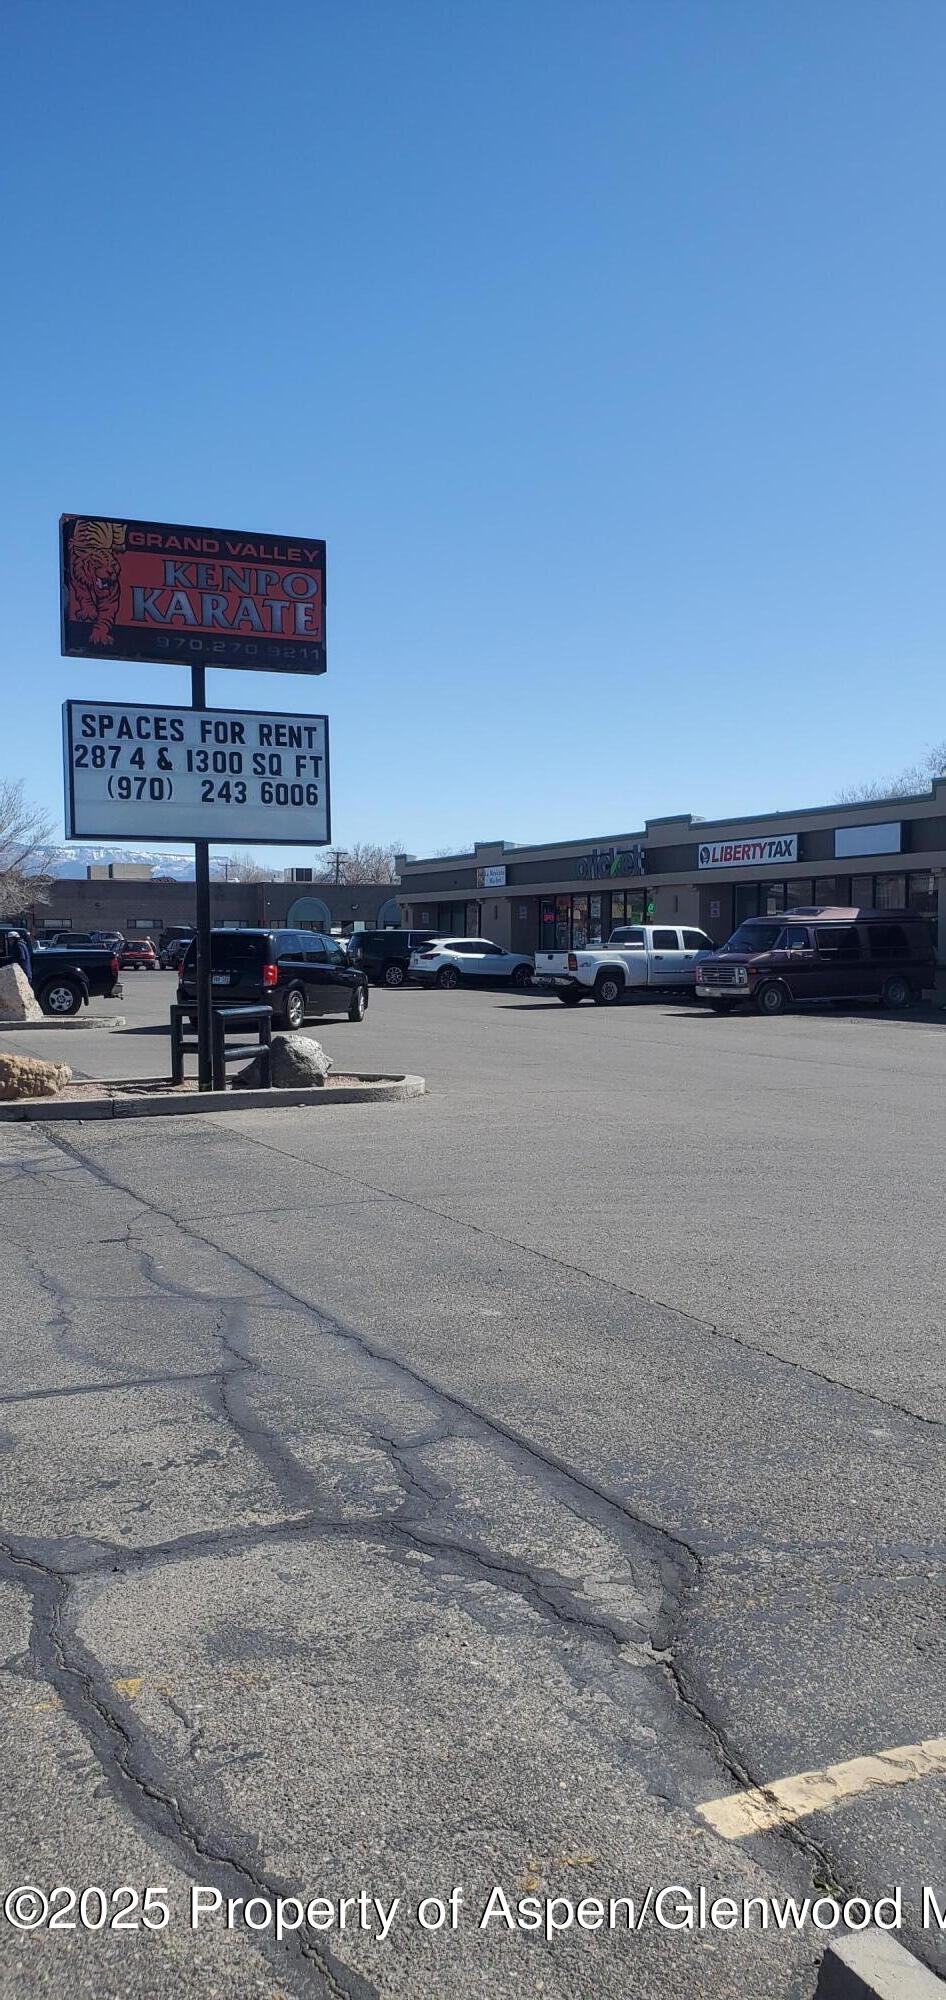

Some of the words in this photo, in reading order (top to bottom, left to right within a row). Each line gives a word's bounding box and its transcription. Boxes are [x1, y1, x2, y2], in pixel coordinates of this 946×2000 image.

[128, 531, 220, 554] GRAND
[226, 542, 320, 563] VALLEY
[162, 559, 319, 600] KENPO
[130, 586, 320, 638] KARATE
[156, 637, 320, 660] 970.2709211
[81, 713, 185, 742] SPACES
[200, 719, 246, 745] FOR
[258, 723, 317, 749] RENT
[156, 746, 173, 771] &
[187, 749, 243, 775] 1300
[252, 752, 283, 778] SQ
[295, 755, 323, 778] FT
[107, 775, 174, 801] (970)
[201, 779, 247, 804] 243
[260, 781, 319, 807] 6006
